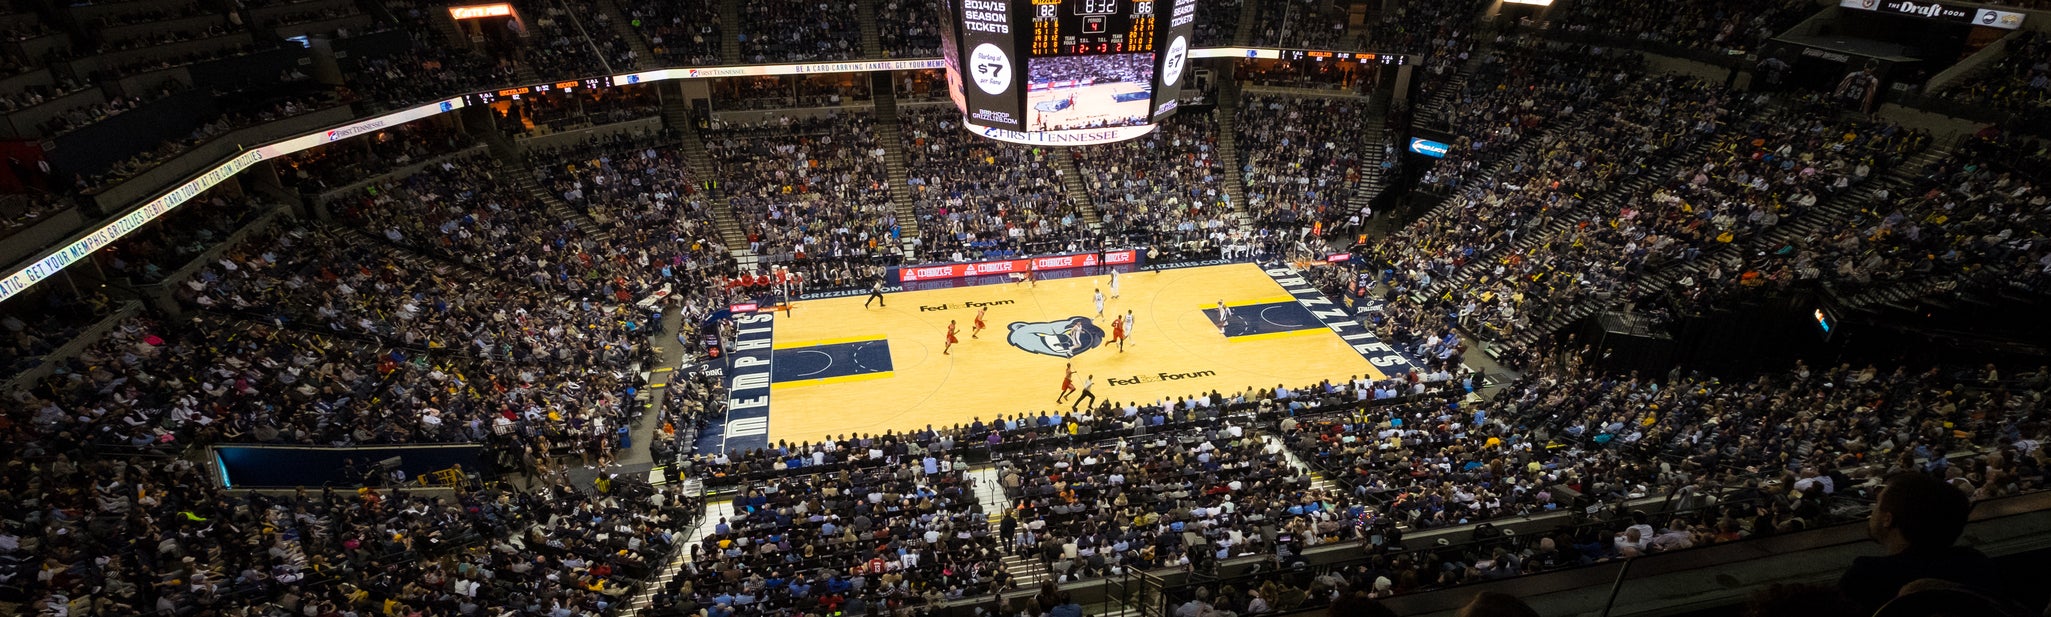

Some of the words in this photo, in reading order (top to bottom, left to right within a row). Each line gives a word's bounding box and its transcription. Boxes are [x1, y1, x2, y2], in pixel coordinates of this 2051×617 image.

[965, 0, 1006, 12] 2014/15
[1040, 4, 1054, 17] 82
[1086, 0, 1115, 12] 8:32
[1138, 2, 1152, 13] 86
[1900, 1, 1942, 18] Draft
[965, 10, 1007, 23] SEASON
[1171, 14, 1194, 28] TICKETS
[965, 21, 1009, 34] TICKETS
[1080, 44, 1084, 53] 2
[1102, 44, 1107, 52] 3
[1116, 43, 1121, 51] 2
[1168, 54, 1182, 69] $7
[978, 63, 1003, 77] $7
[337, 129, 353, 138] FIRST
[353, 121, 385, 134] TENNESSEE
[1000, 129, 1032, 141] FIRST
[1039, 130, 1118, 142] TENNESSEE
[26, 264, 45, 281] GET
[45, 251, 70, 271] YOUR
[70, 231, 108, 259] MEMPHIS
[107, 211, 144, 238] GRIZZLIES
[144, 200, 164, 219] DEBIT
[164, 191, 182, 208] CARD
[181, 180, 202, 198] TODAY
[201, 176, 210, 188] AT
[1357, 304, 1383, 314] SPALDING
[1265, 267, 1406, 368] GRIZZLIES
[725, 313, 773, 439] MEMPHIS
